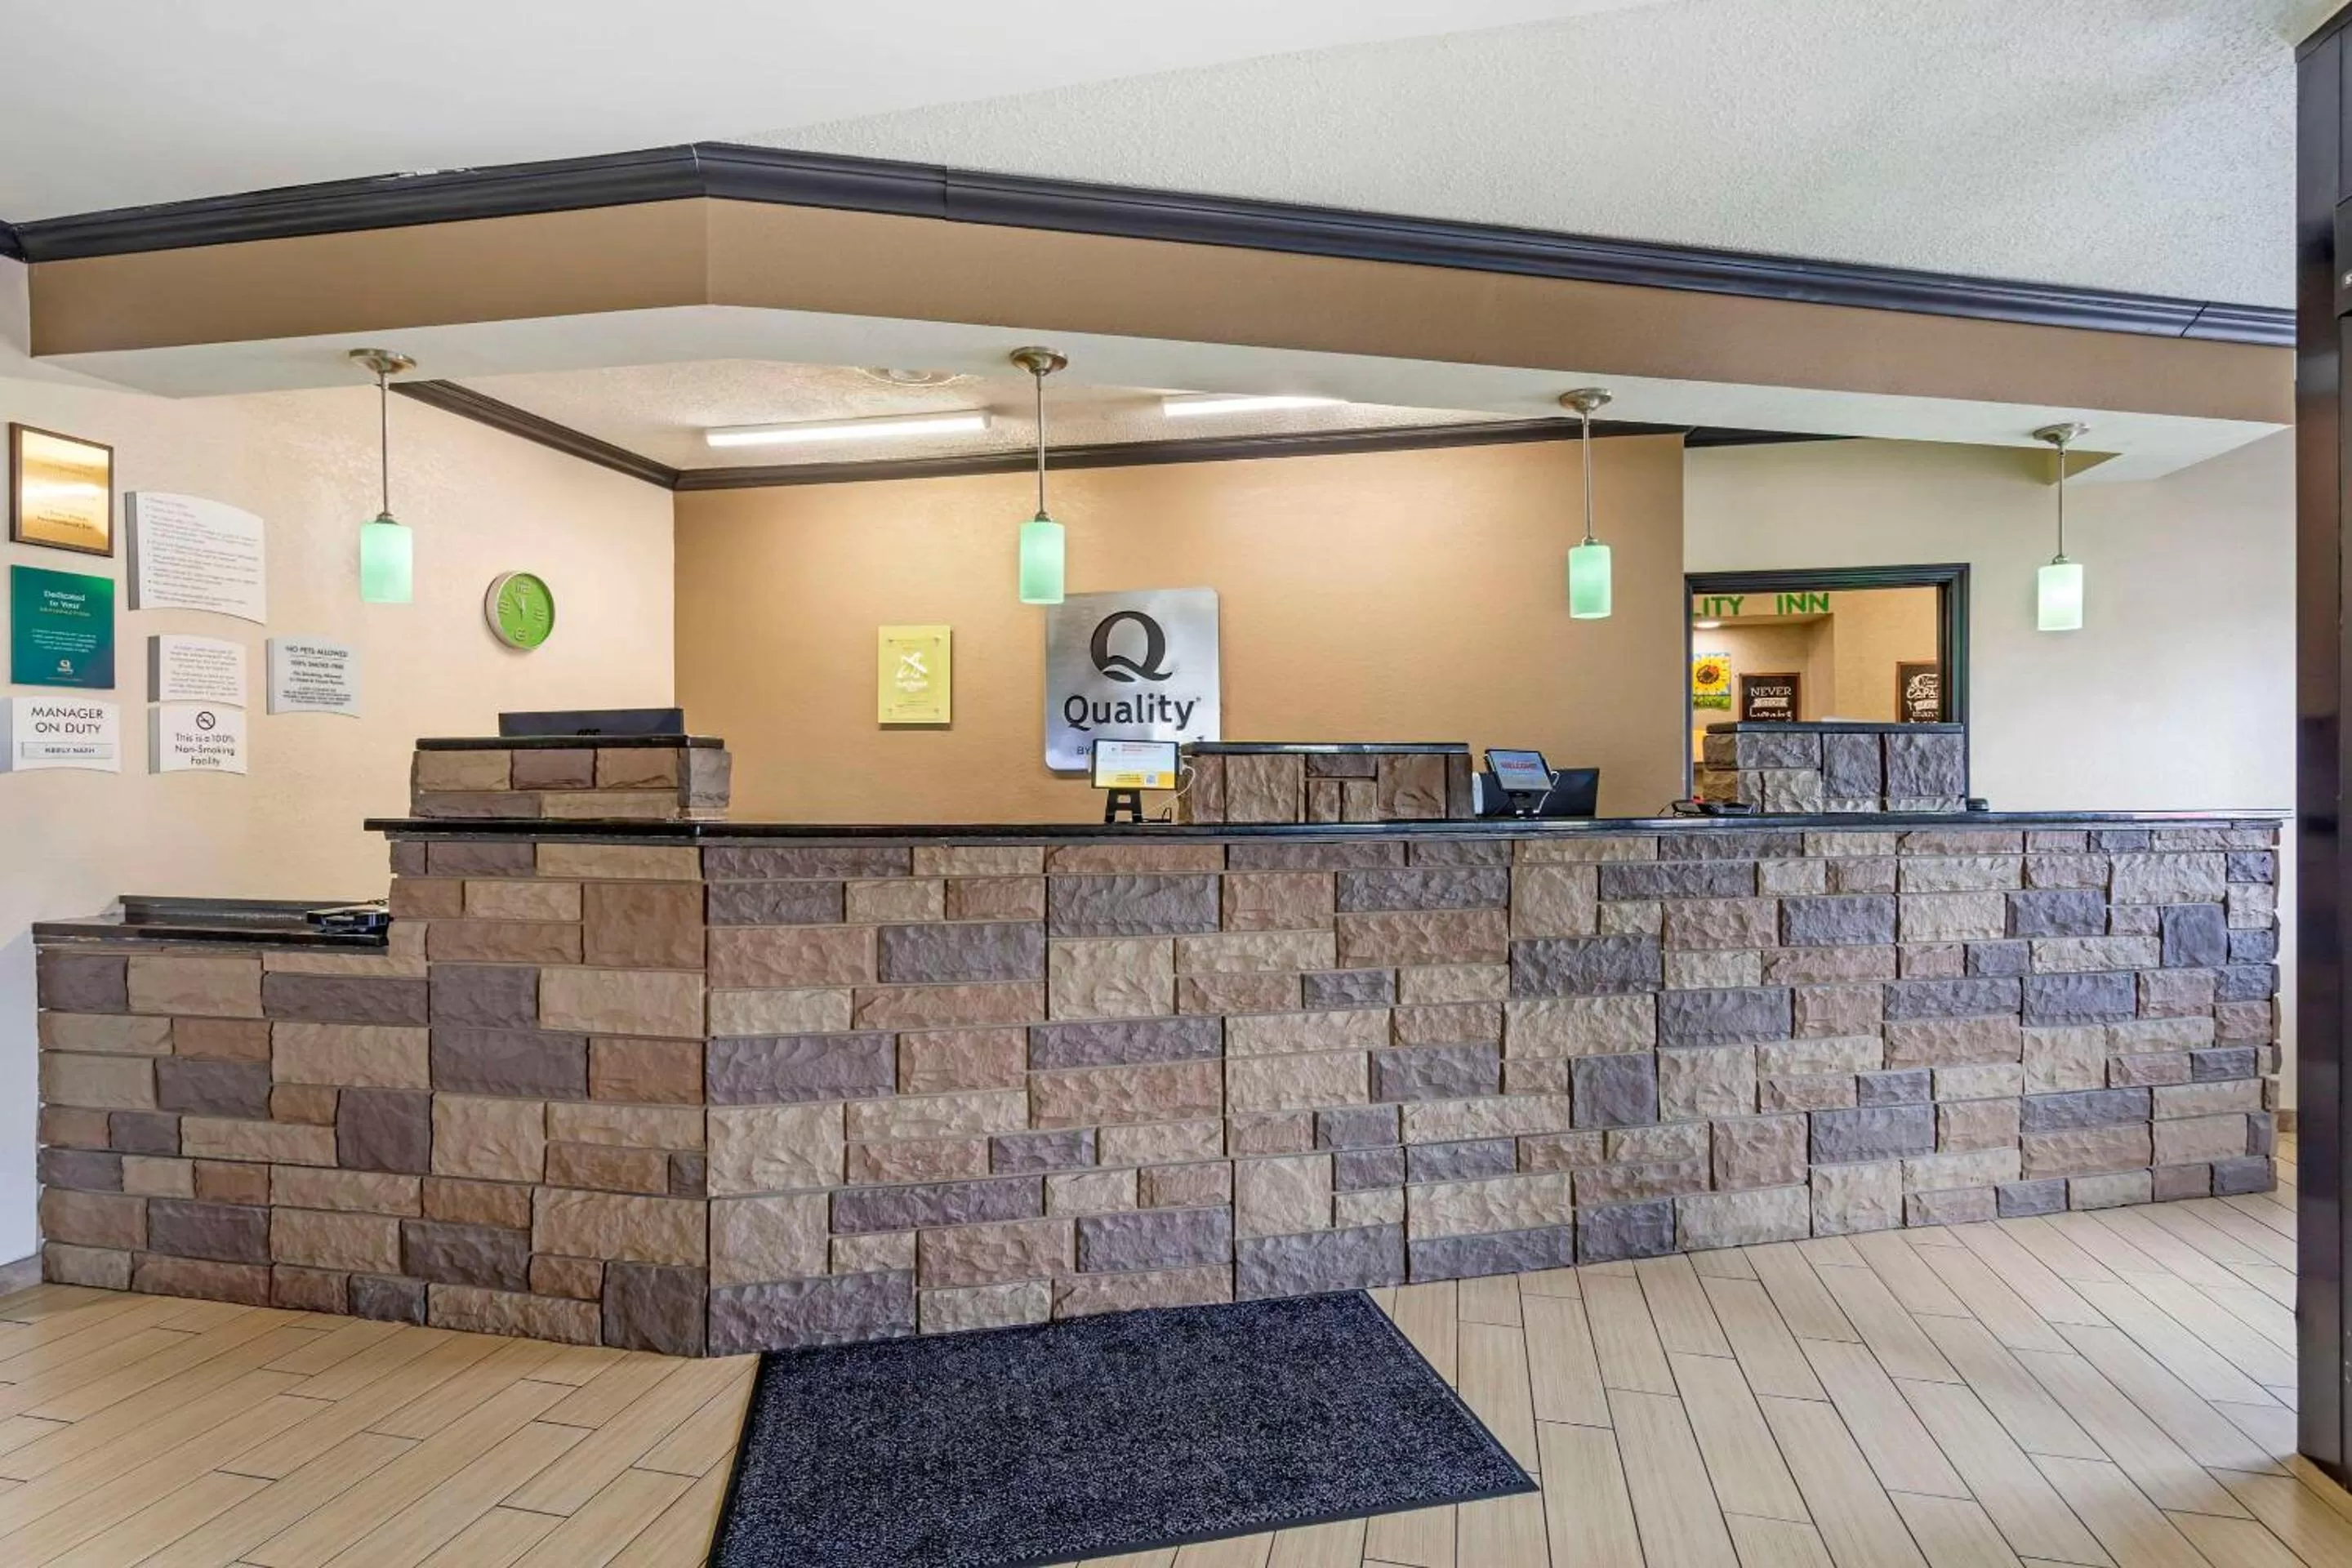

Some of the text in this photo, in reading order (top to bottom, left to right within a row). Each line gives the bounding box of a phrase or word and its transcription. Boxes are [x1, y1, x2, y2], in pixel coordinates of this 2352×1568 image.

[1693, 592, 1829, 617] ITY INN
[317, 648, 348, 657] ALLOWED
[1750, 686, 1793, 697] NEVER
[31, 706, 104, 719] MANAGER
[1064, 693, 1195, 731] Quality
[35, 722, 101, 734] ON DUTY
[176, 733, 193, 742] This
[175, 744, 235, 756] Non-Smoking
[1076, 746, 1092, 755] BY
[190, 755, 220, 767] Facility
